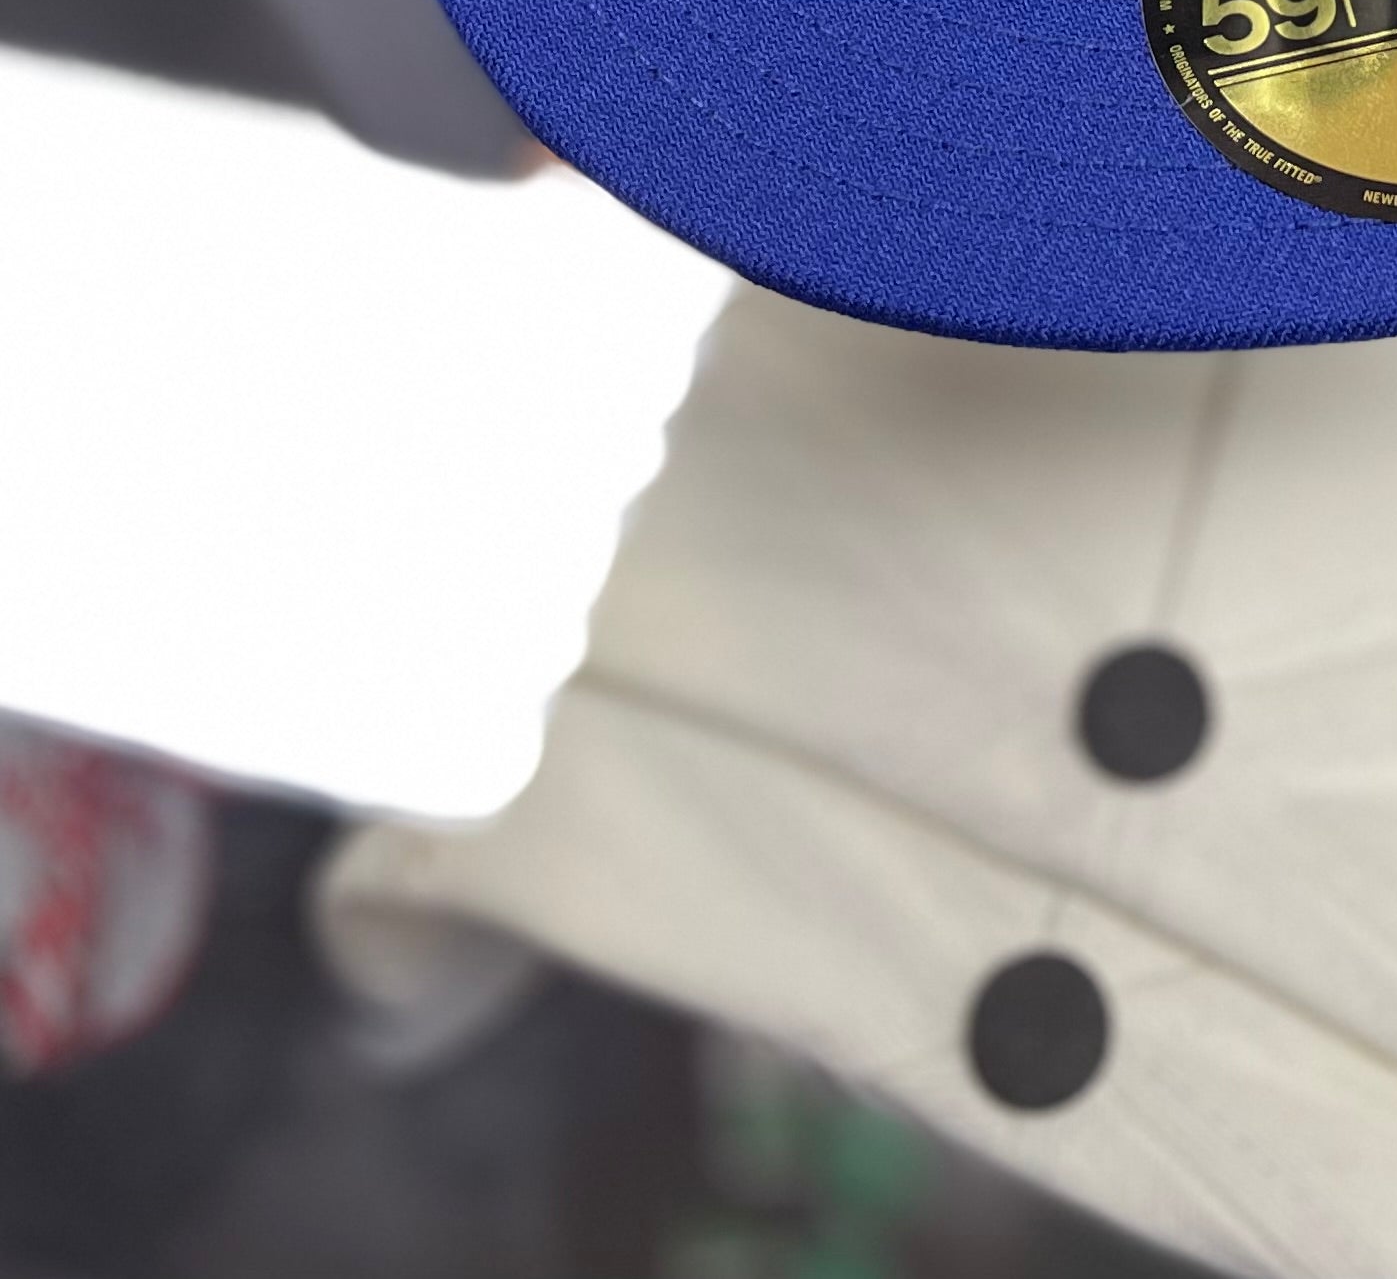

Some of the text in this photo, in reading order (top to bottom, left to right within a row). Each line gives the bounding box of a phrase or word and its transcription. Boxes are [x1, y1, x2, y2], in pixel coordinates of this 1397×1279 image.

[1169, 44, 1214, 110] ORIGINATORS
[1208, 107, 1227, 123] OF
[1221, 120, 1246, 143] THE
[1243, 137, 1275, 165] TRUE
